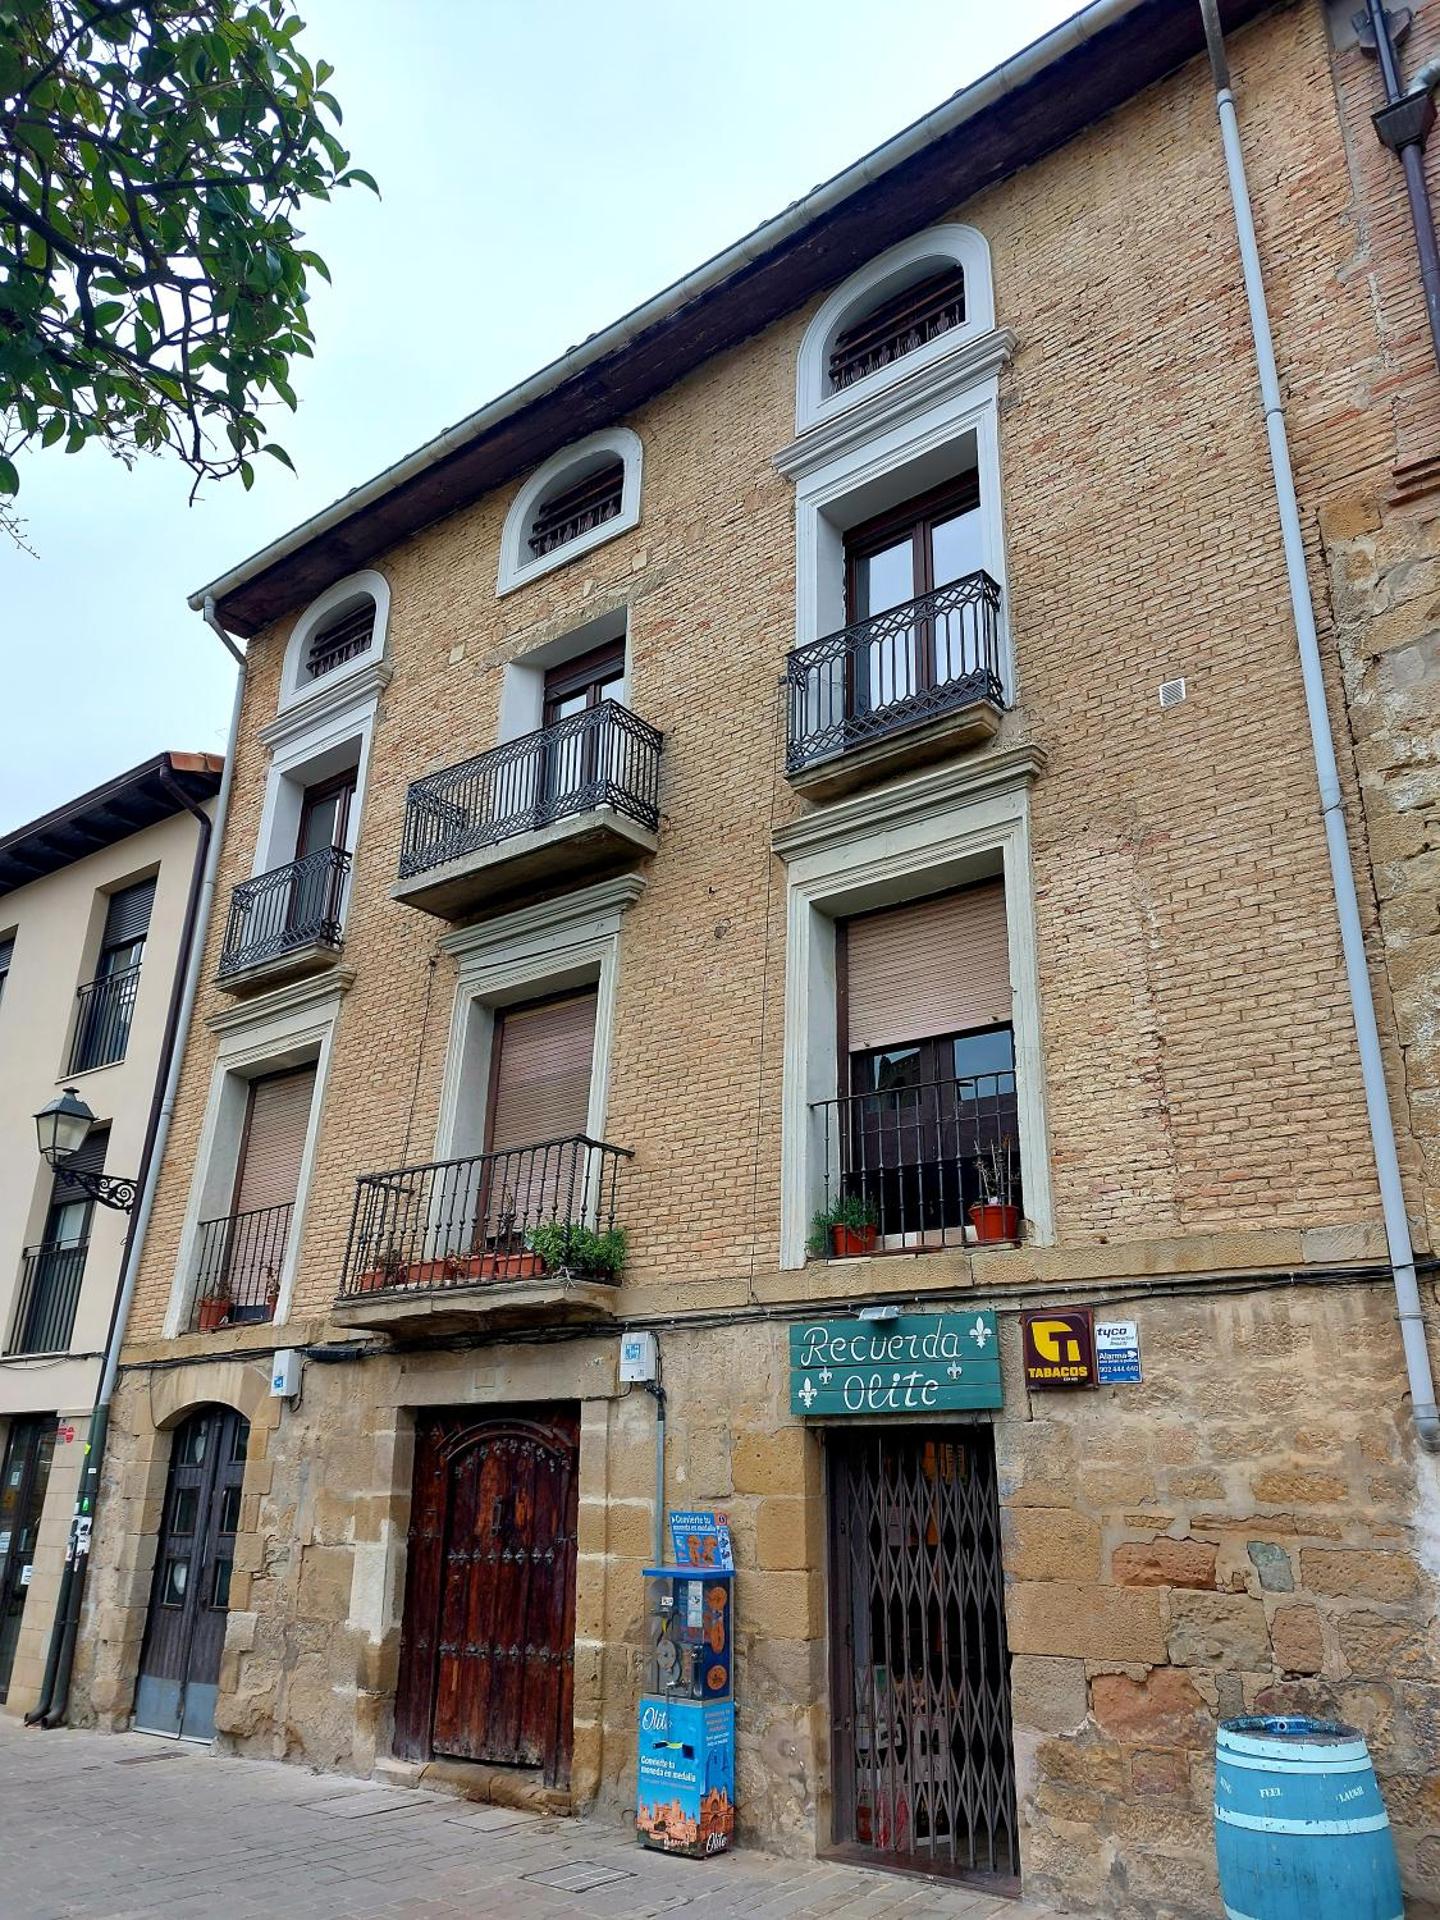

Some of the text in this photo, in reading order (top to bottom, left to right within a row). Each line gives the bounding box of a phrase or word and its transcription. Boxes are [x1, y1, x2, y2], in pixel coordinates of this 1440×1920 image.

[1097, 1328, 1127, 1338] tyco
[801, 1318, 963, 1366] Recuerda
[1099, 1352, 1127, 1360] Alarma
[1028, 1366, 1088, 1378] TABACOS
[844, 1370, 939, 1410] Olite
